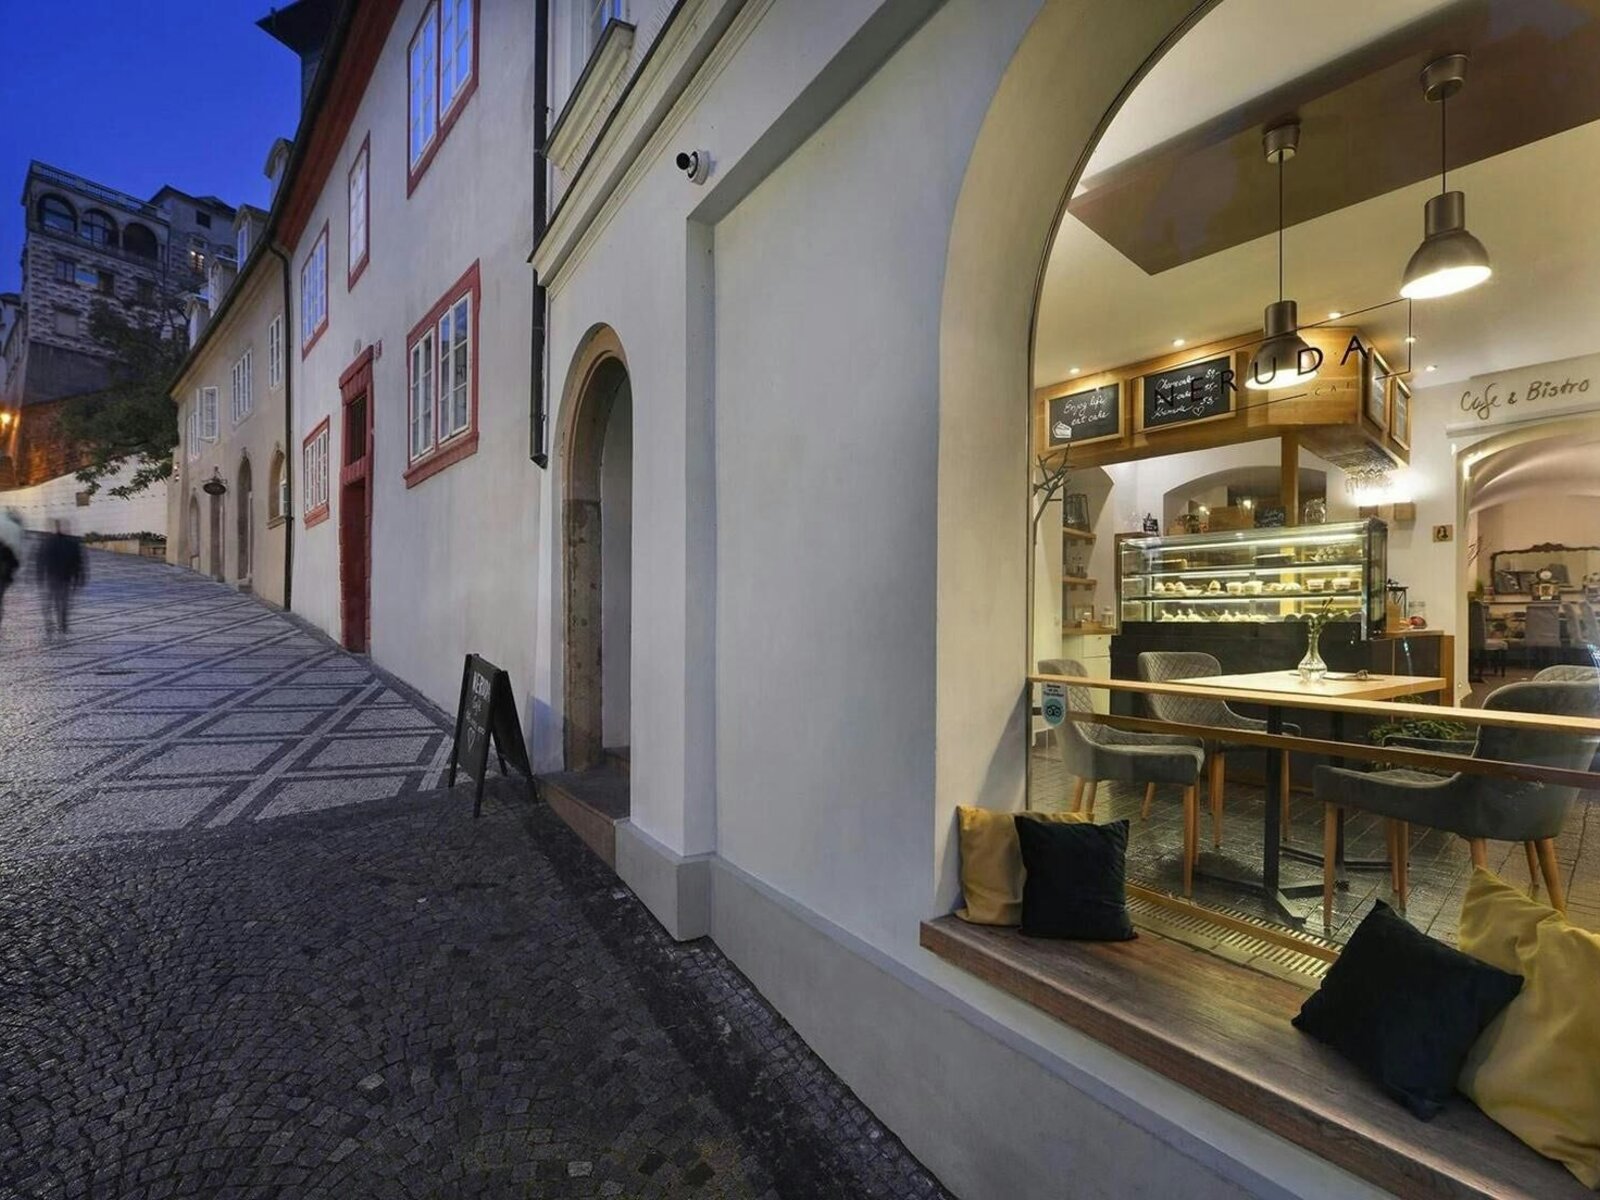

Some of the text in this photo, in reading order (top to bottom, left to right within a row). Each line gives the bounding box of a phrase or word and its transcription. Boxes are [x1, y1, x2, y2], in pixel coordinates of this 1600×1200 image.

[1154, 334, 1369, 411] NERUDA
[1507, 391, 1518, 405] &
[1526, 378, 1591, 401] Bistro
[1063, 400, 1088, 417] Enjoy
[1071, 409, 1110, 426] eat cake
